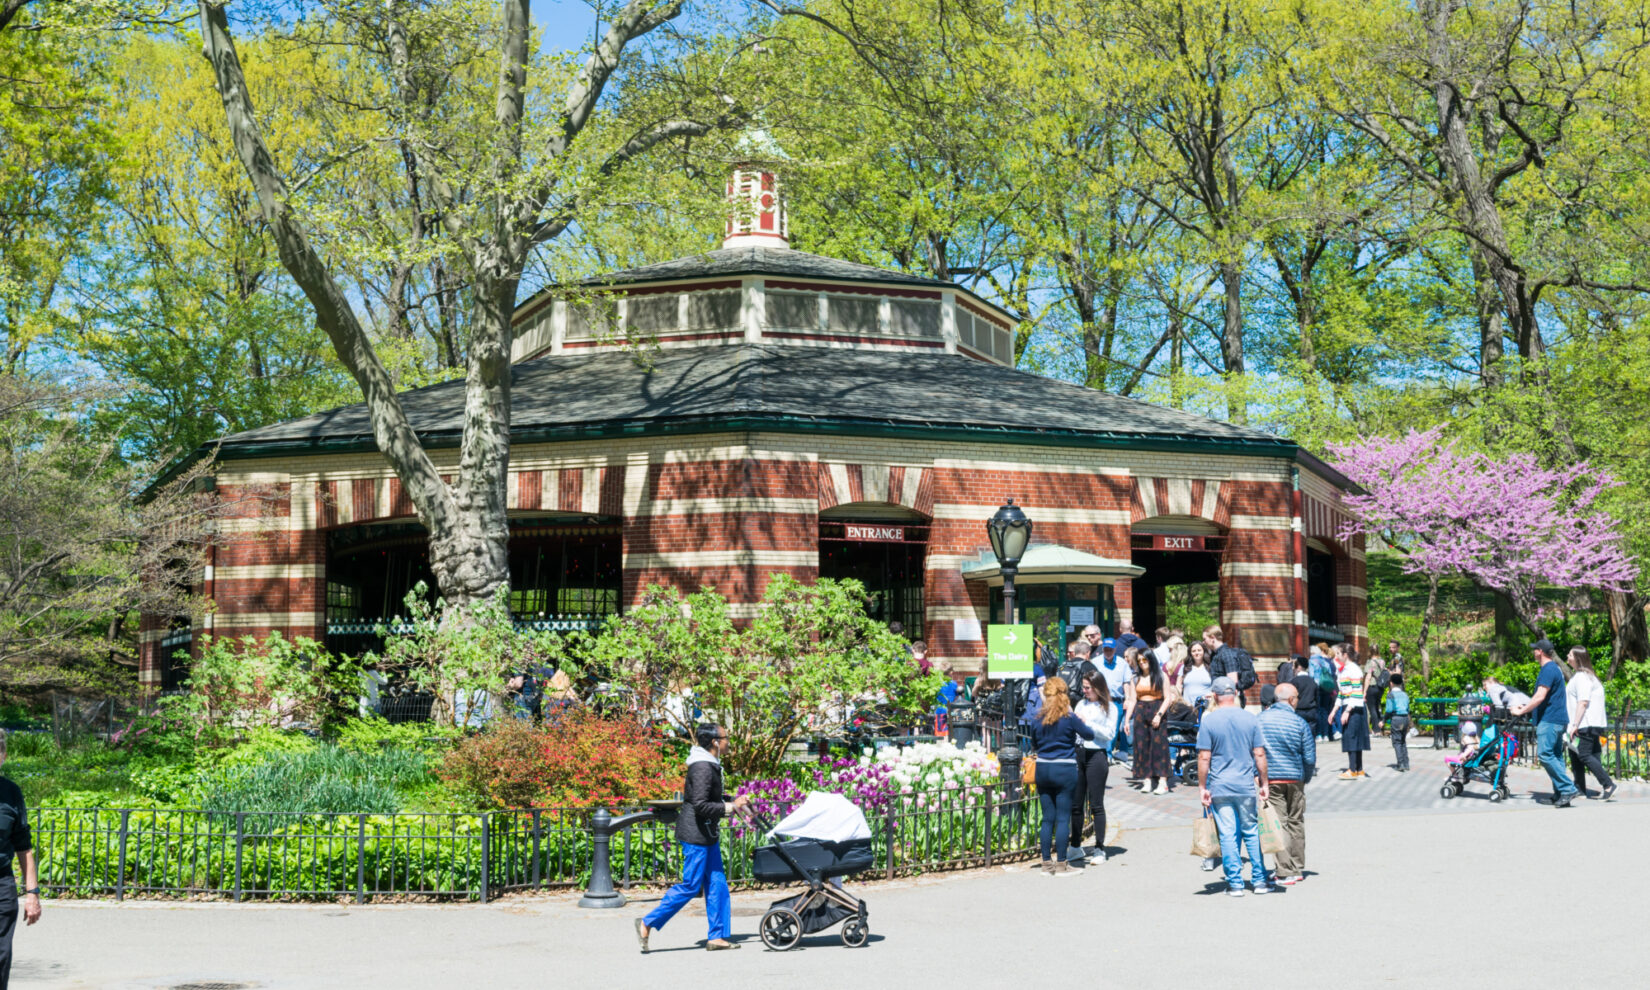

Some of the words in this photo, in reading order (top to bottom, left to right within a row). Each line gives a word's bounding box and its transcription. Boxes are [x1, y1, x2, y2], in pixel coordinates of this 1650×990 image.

[847, 526, 903, 540] ENTRANCE
[1164, 537, 1194, 548] EXIT
[993, 652, 1007, 661] The
[1008, 652, 1028, 662] Dairy
